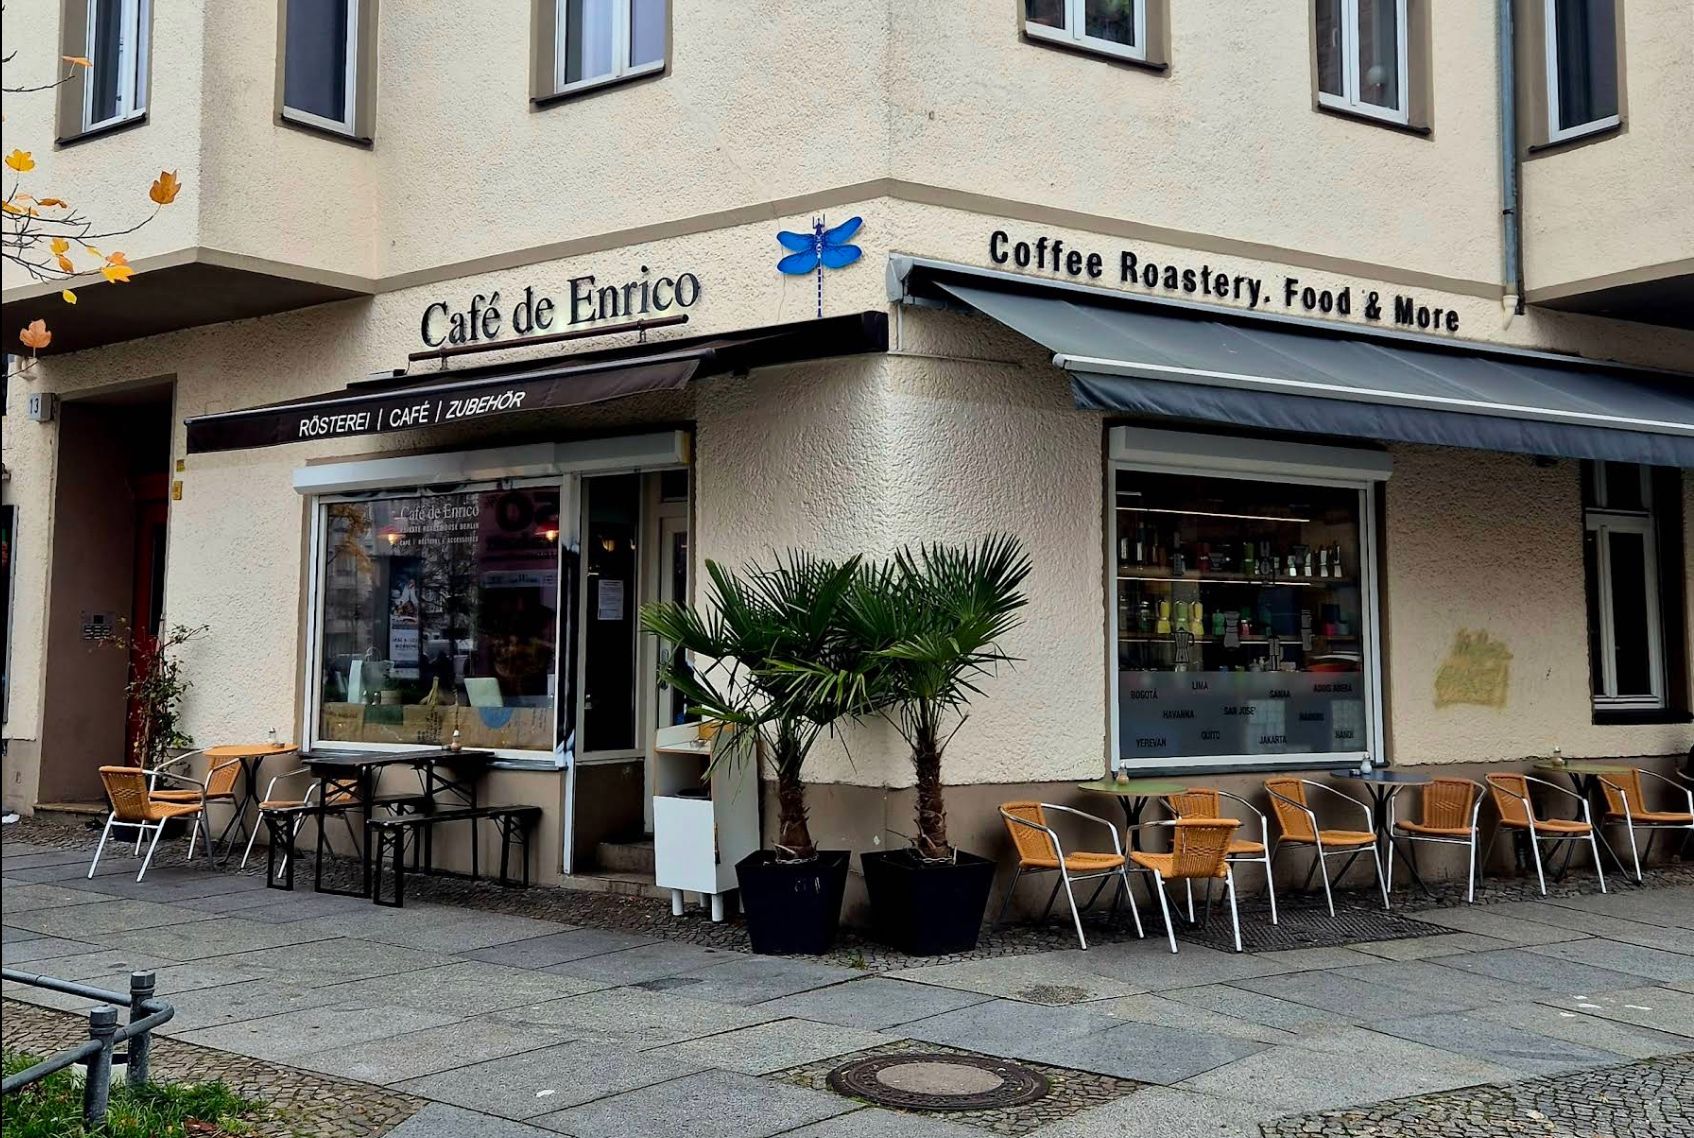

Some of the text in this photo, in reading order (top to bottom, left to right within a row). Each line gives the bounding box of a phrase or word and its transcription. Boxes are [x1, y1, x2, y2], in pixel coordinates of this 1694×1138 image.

[989, 230, 1103, 278] Coffee
[1285, 278, 1351, 316] Food
[1365, 290, 1382, 321] &
[1394, 295, 1460, 332] More
[420, 265, 702, 348] Café de Enrico
[30, 397, 39, 414] 13
[298, 412, 370, 437] RÖSTEREI
[389, 402, 430, 428] CAFÉ
[445, 390, 527, 420] ZUBEHÖR
[400, 502, 480, 521] Café de Enrico
[1192, 681, 1208, 690] LIMA
[1163, 709, 1194, 719] HAVANNA
[1201, 731, 1220, 740] QUITO
[1259, 736, 1288, 744] JAKARTA
[1136, 738, 1167, 748] YEREVAN
